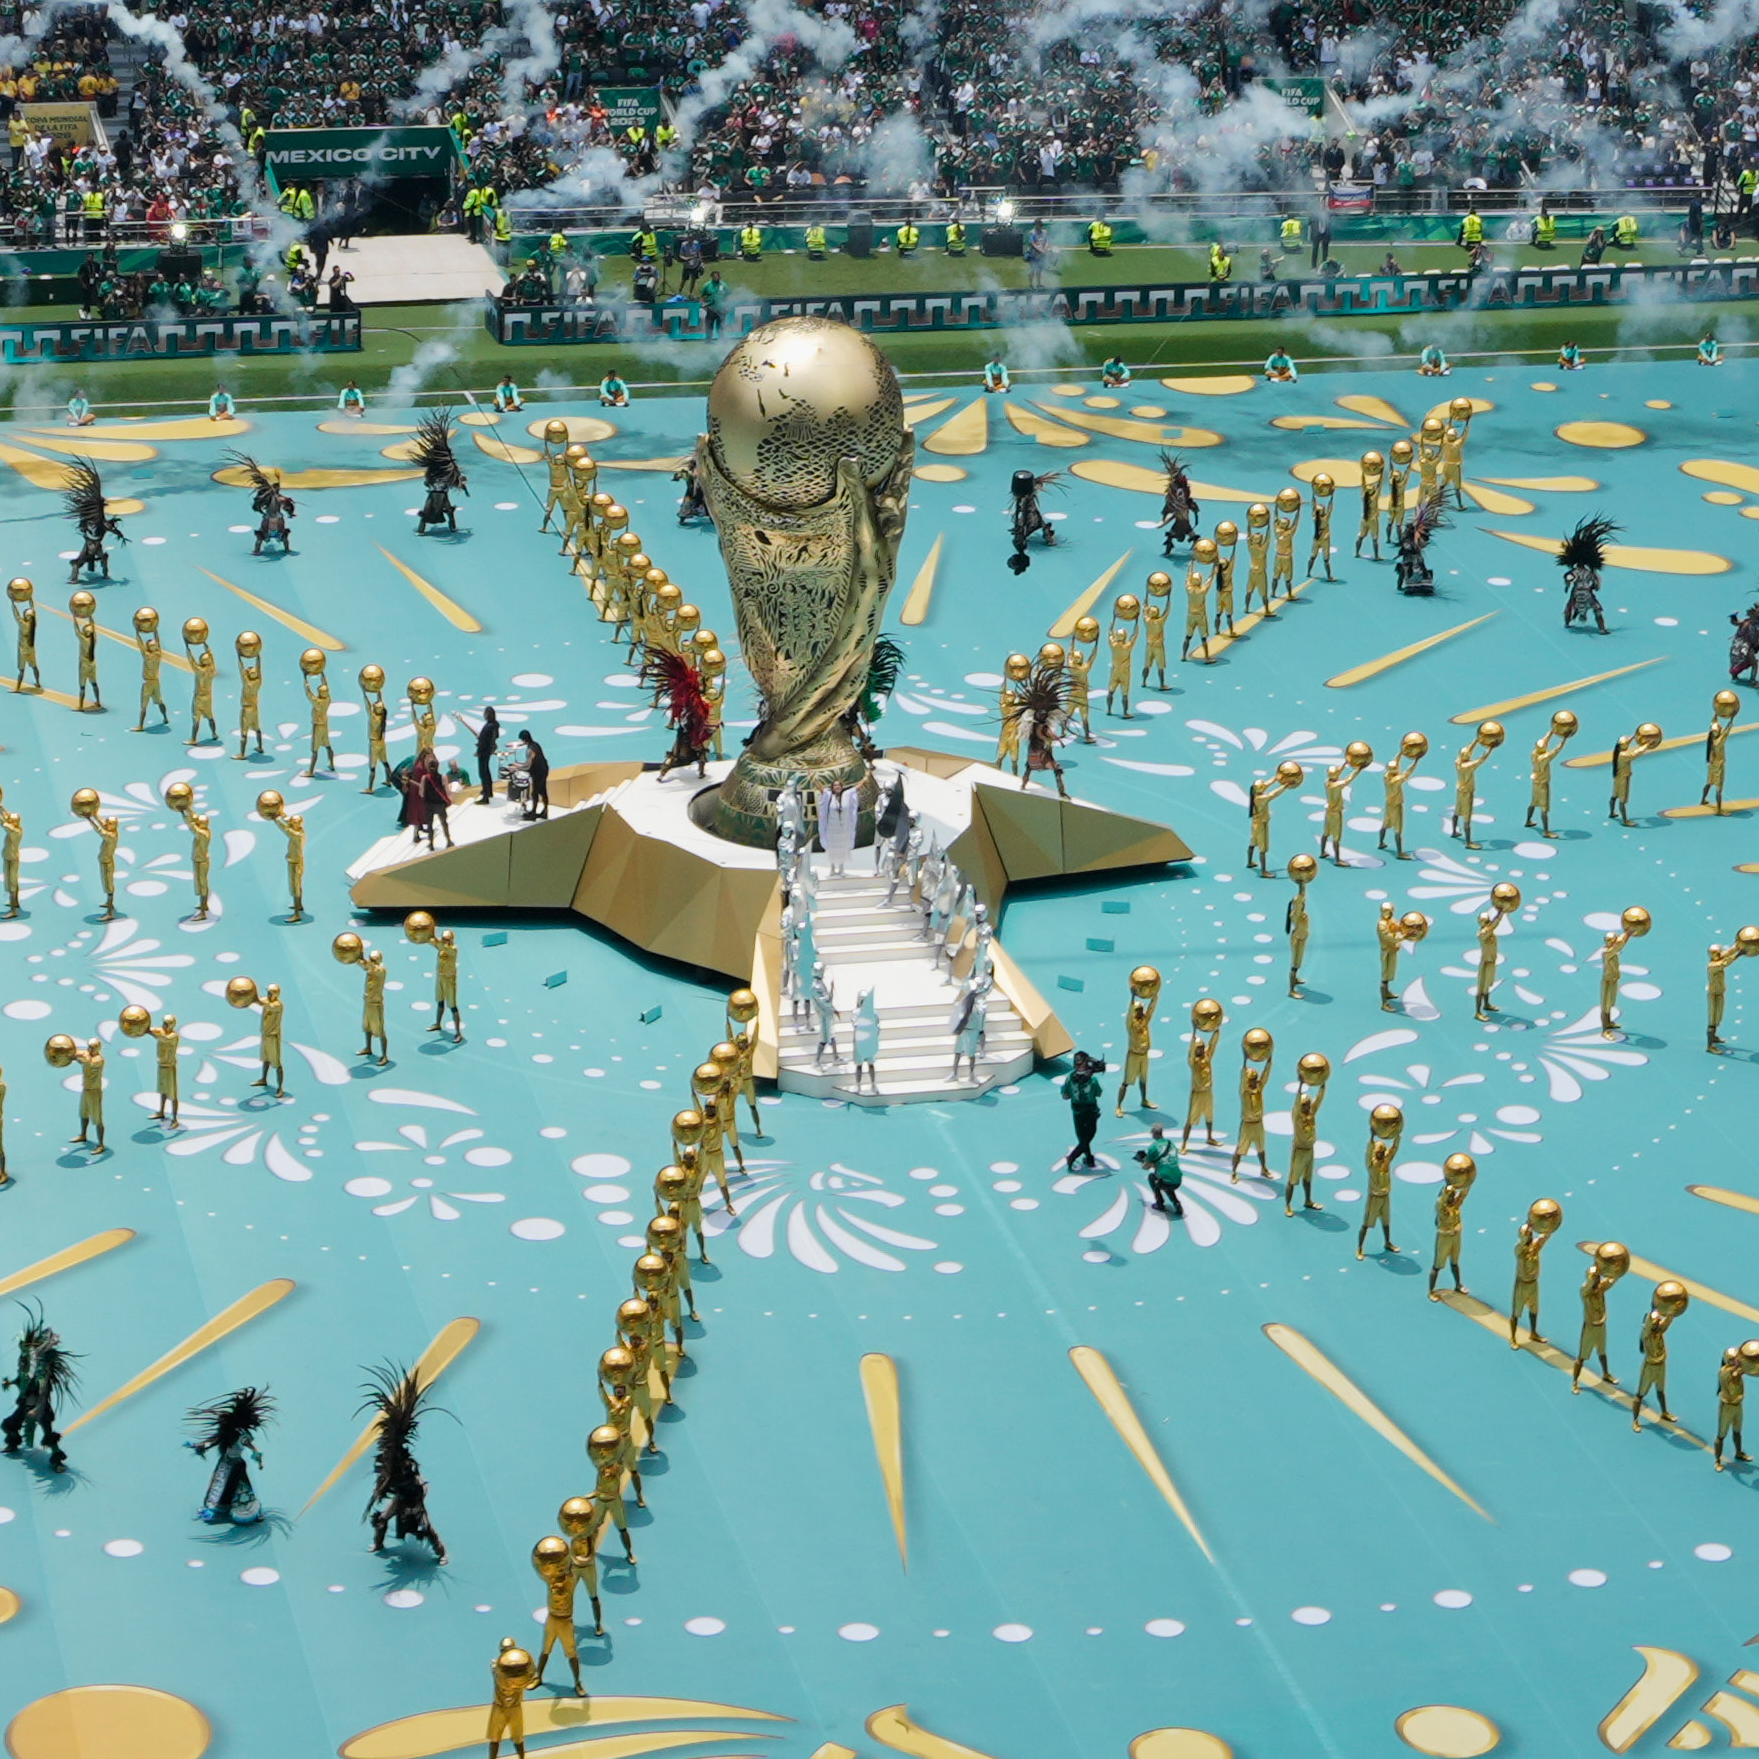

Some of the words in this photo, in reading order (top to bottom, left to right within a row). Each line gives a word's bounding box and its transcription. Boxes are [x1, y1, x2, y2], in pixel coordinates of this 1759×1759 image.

[1282, 87, 1303, 97] FIFA
[617, 98, 640, 108] FIFA
[1300, 96, 1321, 106] CUP
[606, 107, 637, 117] ORLD
[637, 106, 658, 116] CUP
[27, 115, 49, 124] COPA
[50, 114, 88, 124] MUNDIAL
[59, 122, 78, 131] FIFA
[265, 147, 374, 164] MEXICO
[377, 145, 442, 161] CITY
[540, 308, 619, 339] FIFA
[1220, 287, 1293, 317] FIFA
[72, 326, 153, 357] FIFA
